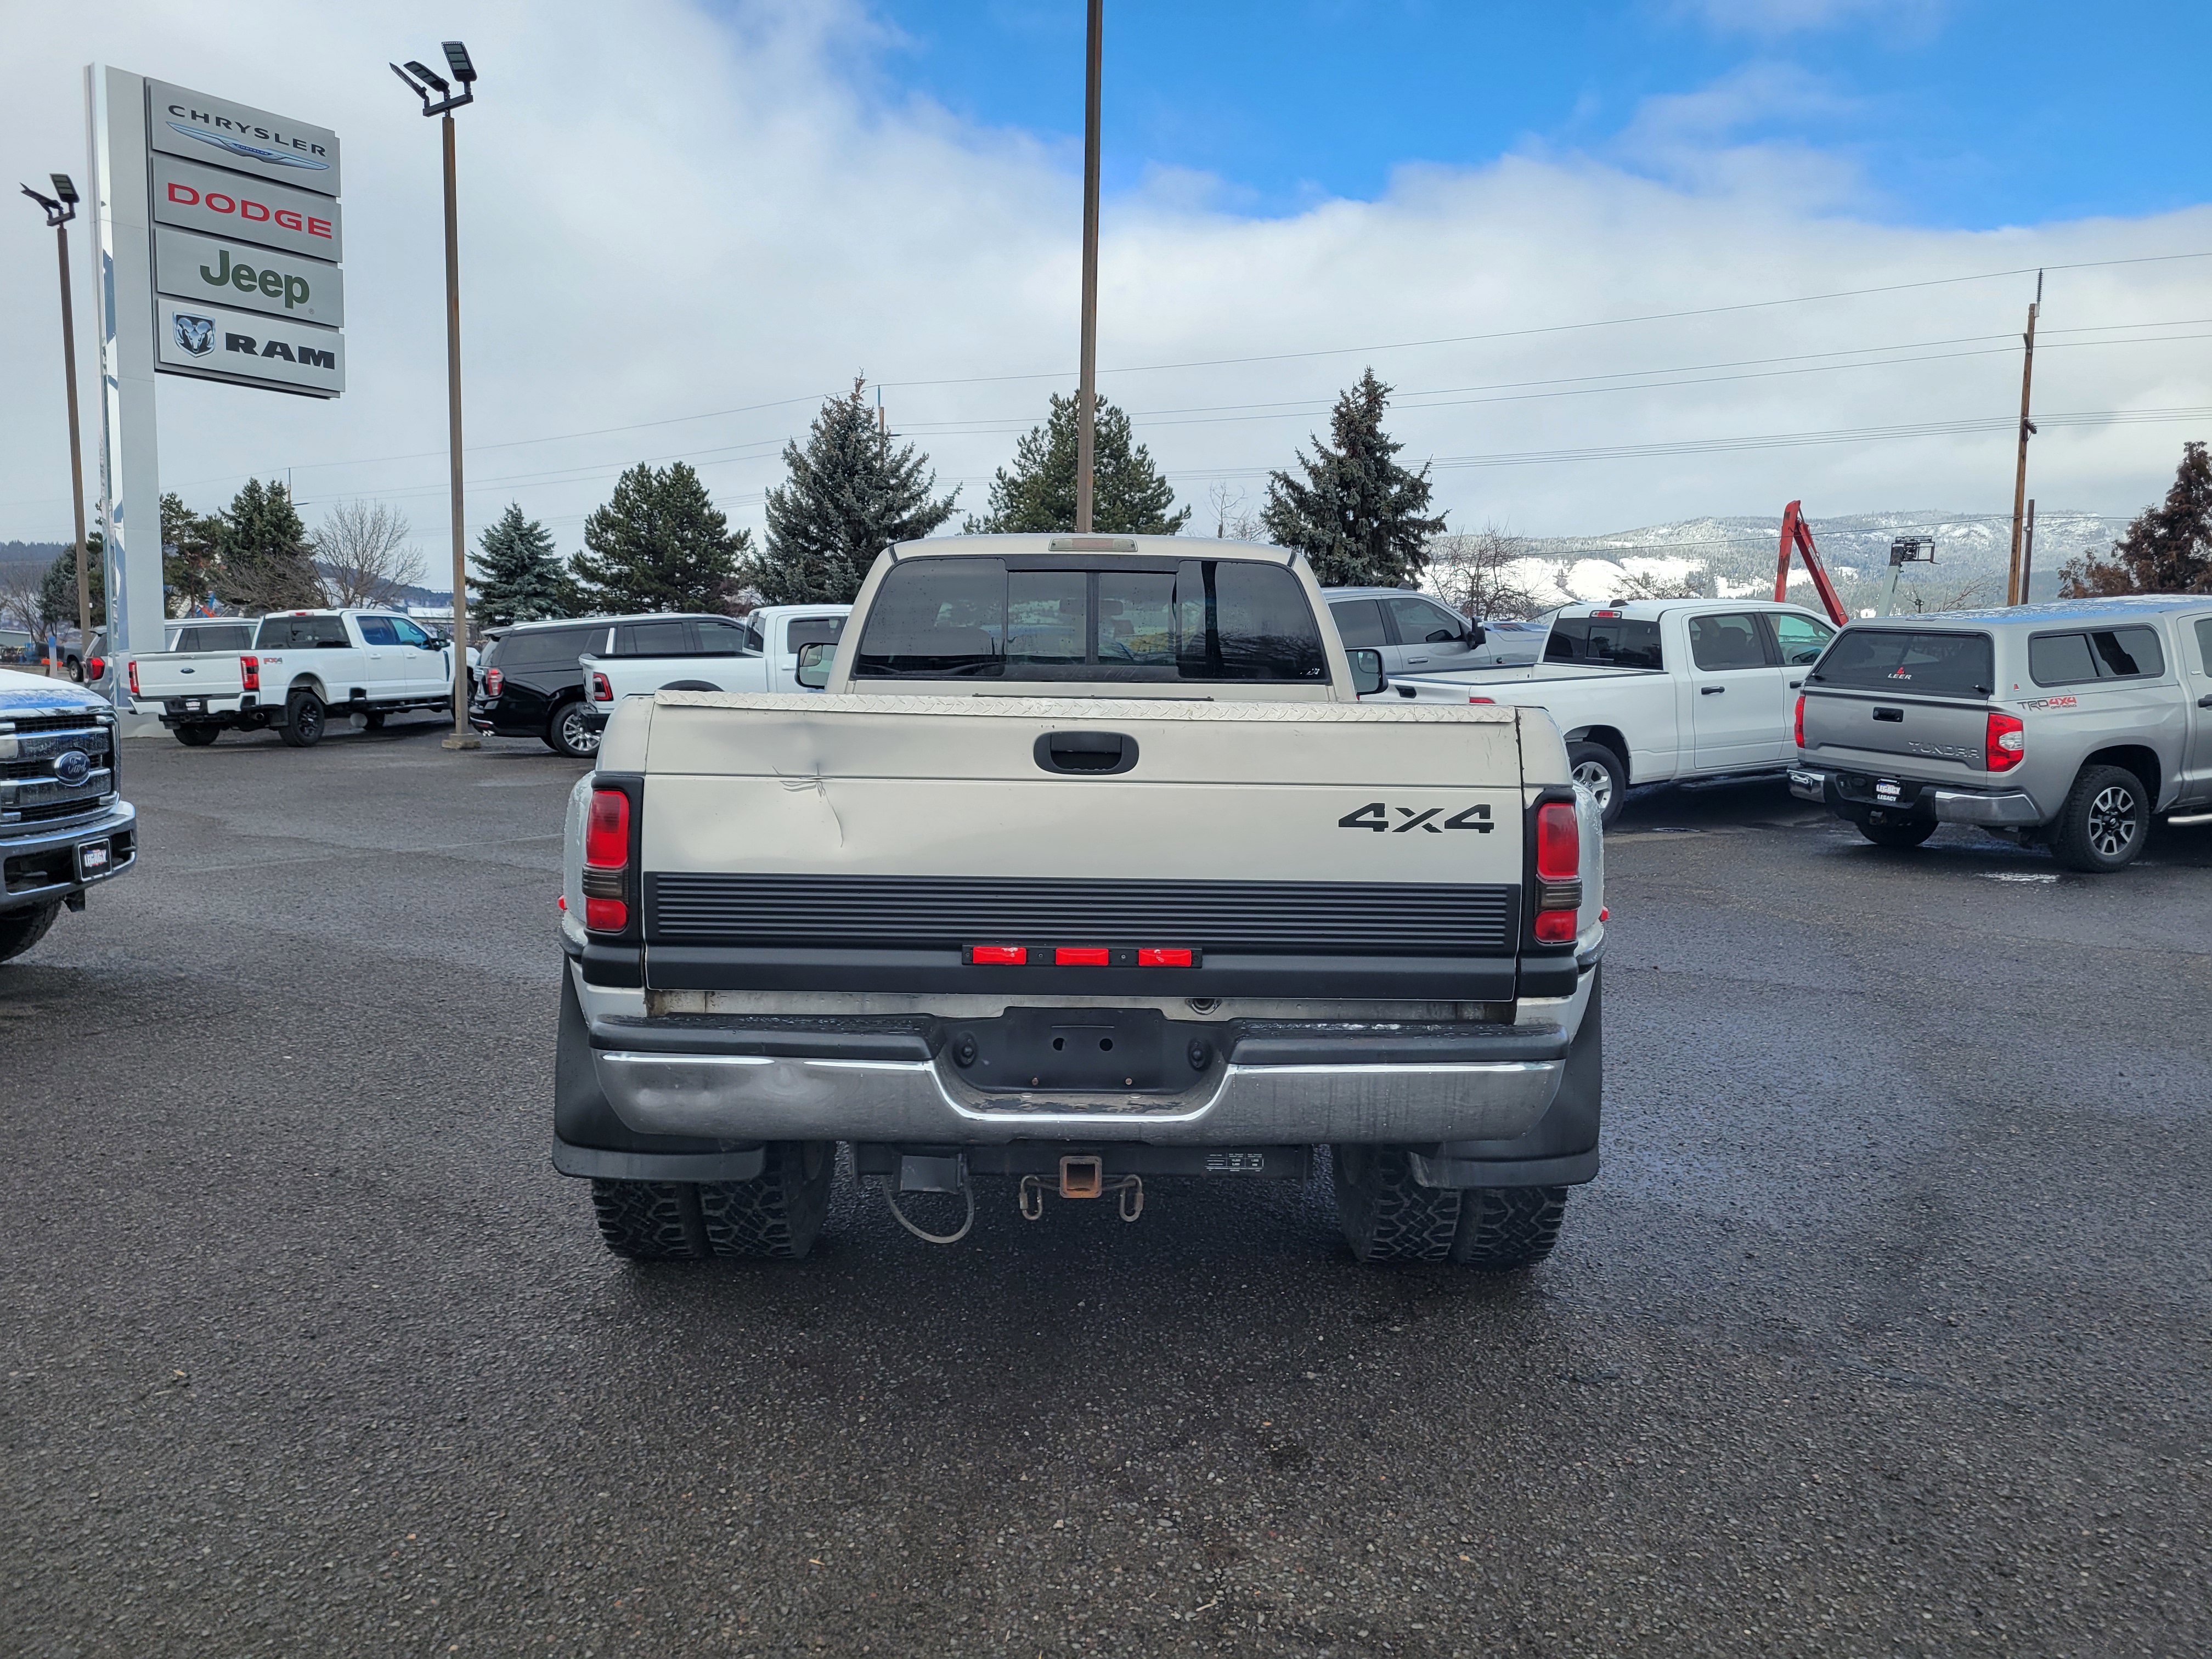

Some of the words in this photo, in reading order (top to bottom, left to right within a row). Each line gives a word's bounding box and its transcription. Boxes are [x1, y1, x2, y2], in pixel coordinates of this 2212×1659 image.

[168, 104, 326, 157] CHRYSLER
[167, 182, 332, 239] DODGE
[200, 250, 309, 309] Jeep
[225, 332, 335, 369] RAM
[2017, 699, 2049, 711] TRD
[1908, 741, 1979, 759] TUNDRA
[68, 757, 87, 775] Ford
[1876, 784, 1900, 795] LEGACY
[84, 849, 108, 867] LEGACY
